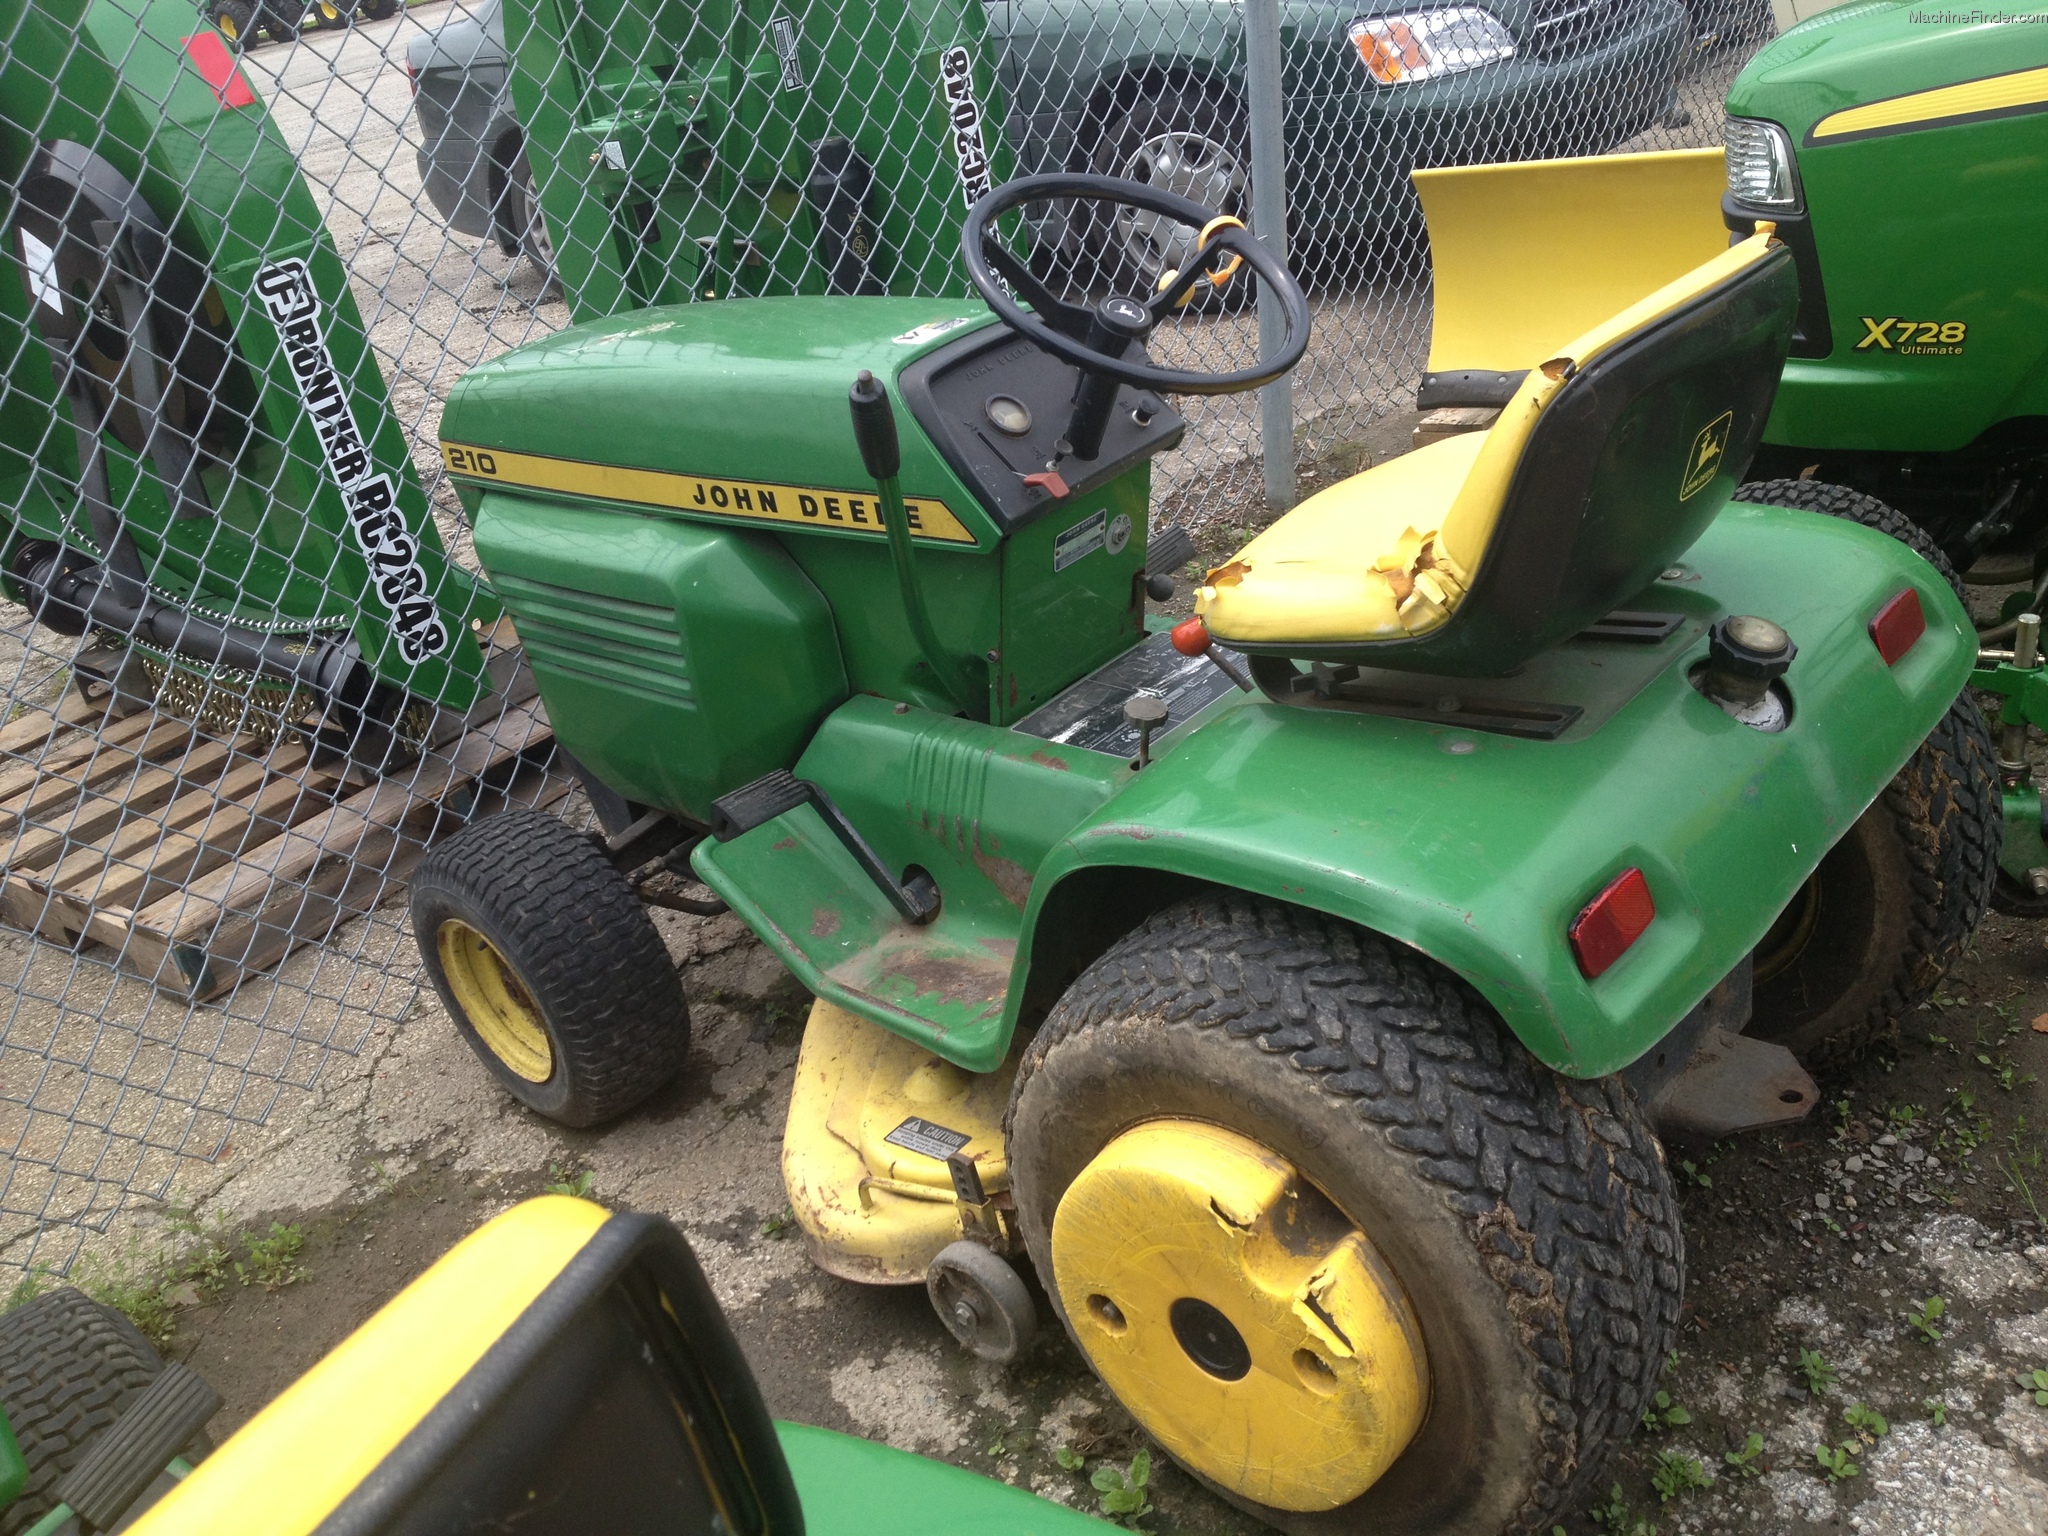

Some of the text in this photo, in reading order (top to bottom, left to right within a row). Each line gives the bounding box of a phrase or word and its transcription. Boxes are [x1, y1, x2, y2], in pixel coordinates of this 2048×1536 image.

[1856, 317, 1967, 349] X728
[1901, 345, 1963, 355] Ultimate
[448, 447, 497, 475] 210
[692, 484, 779, 513] JOHN
[345, 479, 446, 661] RC2048
[923, 1125, 965, 1146] CAUTION
